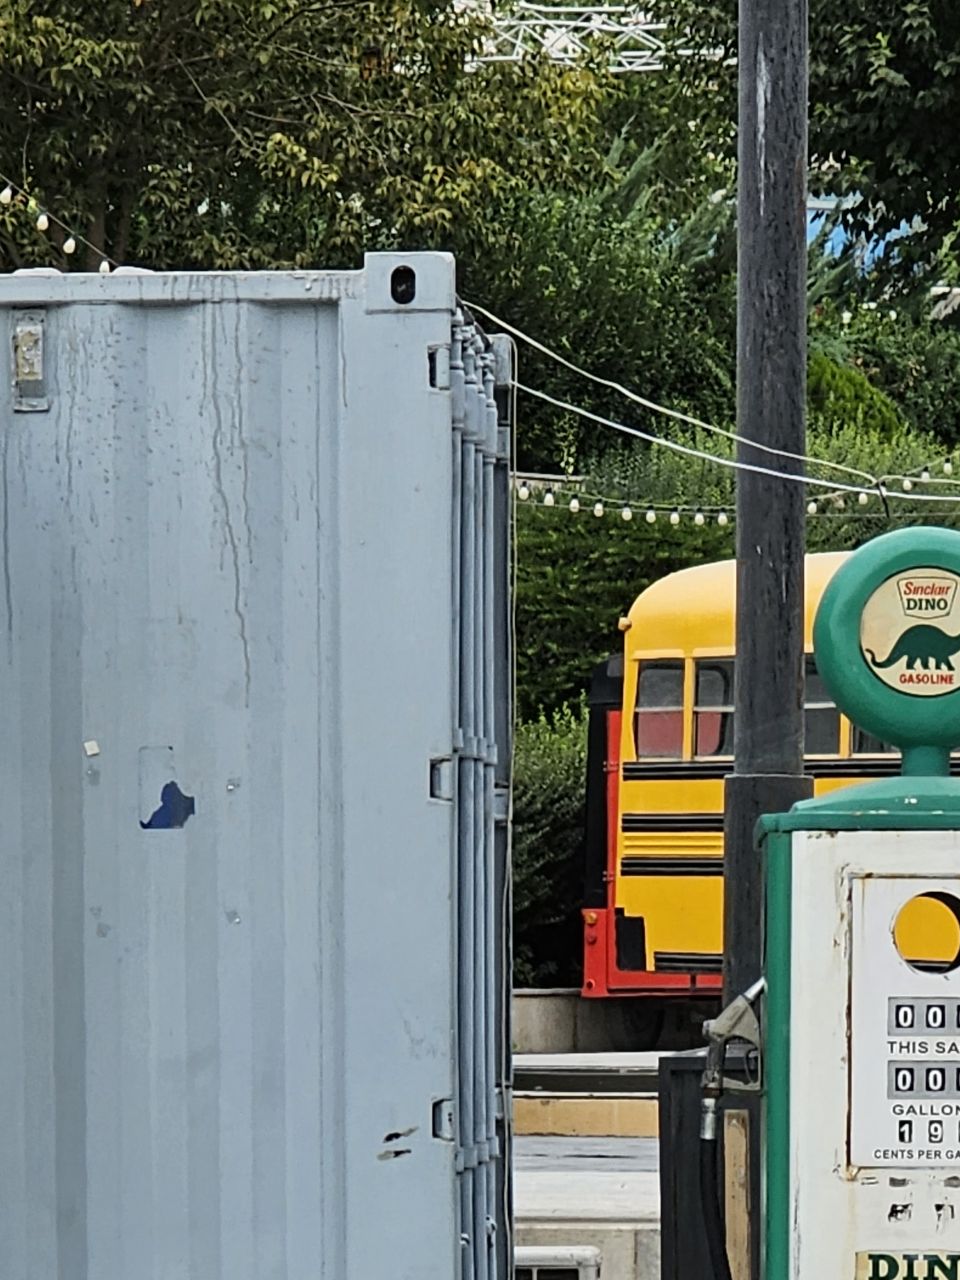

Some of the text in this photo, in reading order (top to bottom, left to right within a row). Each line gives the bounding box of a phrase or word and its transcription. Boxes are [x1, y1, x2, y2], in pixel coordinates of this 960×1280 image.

[903, 581, 951, 596] Sinclair
[906, 598, 948, 611] DINO
[899, 673, 955, 685] GASOLINE
[887, 1041, 928, 1055] THIS
[874, 1149, 914, 1160] CENTS
[917, 1149, 942, 1160] PER
